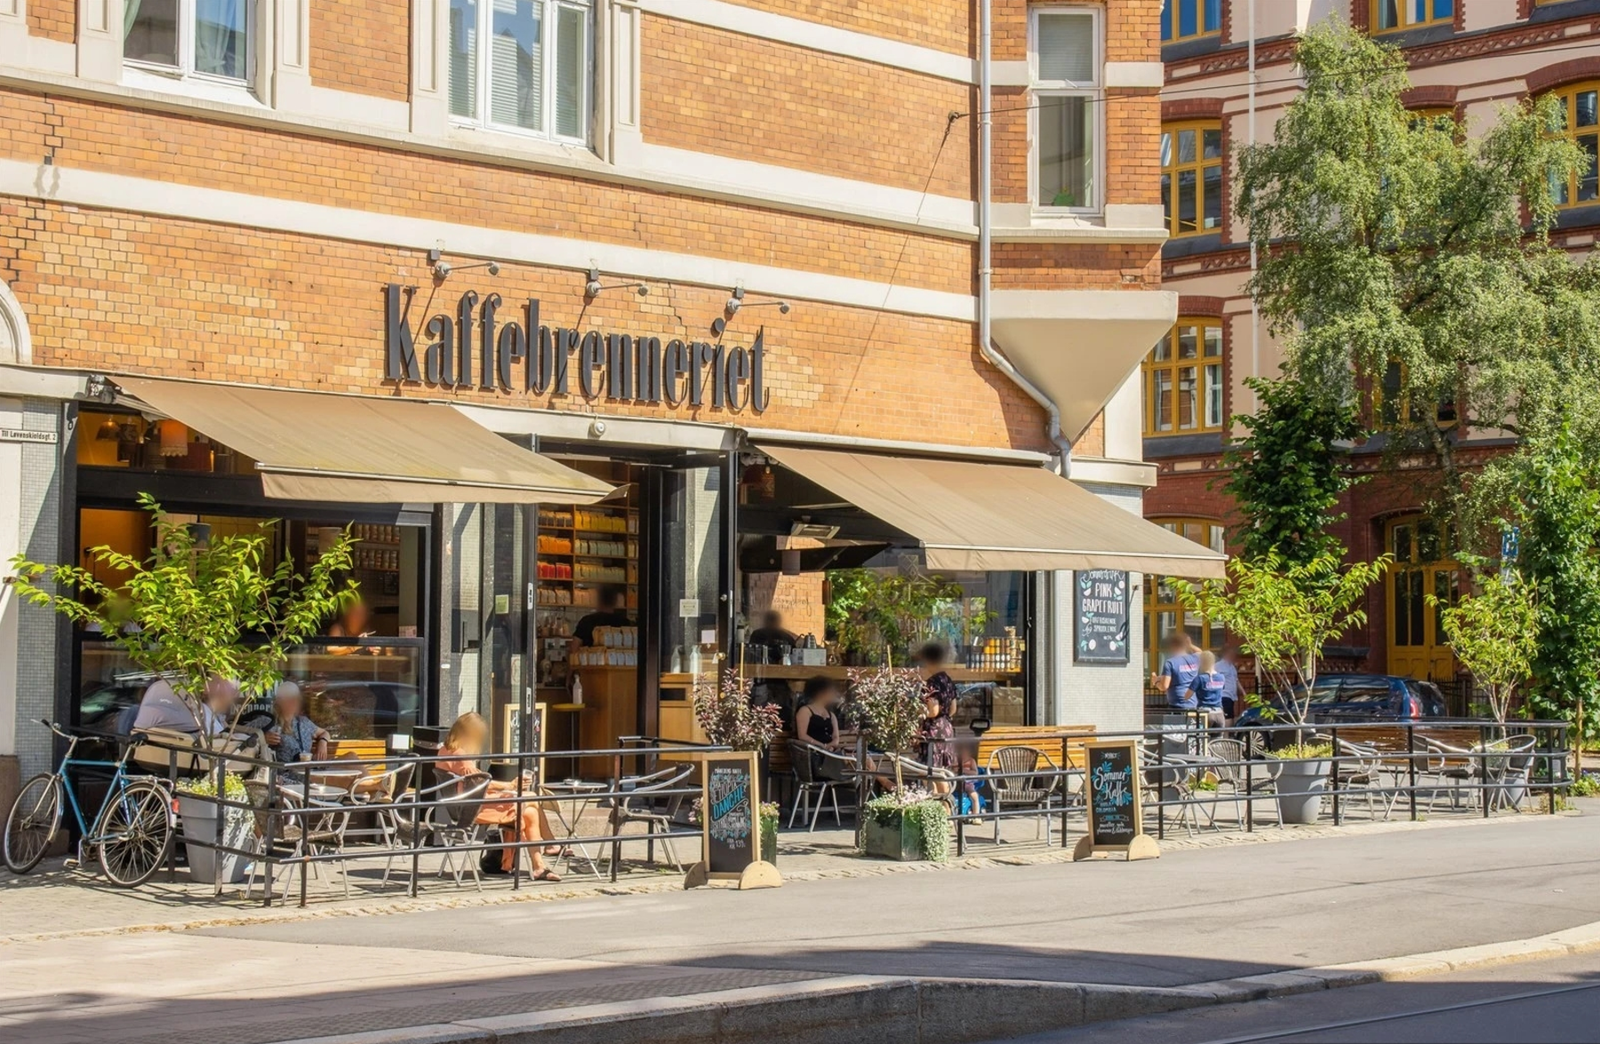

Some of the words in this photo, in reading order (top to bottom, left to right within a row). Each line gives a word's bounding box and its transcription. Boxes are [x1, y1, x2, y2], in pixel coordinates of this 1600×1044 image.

[384, 283, 770, 413] Kaffebrenneriet
[52, 433, 56, 441] 2
[1095, 582, 1112, 597] PINK
[1082, 599, 1122, 614] GRAPEFRUIT
[1094, 766, 1127, 791] Sommer
[713, 784, 746, 820] DANCHE
